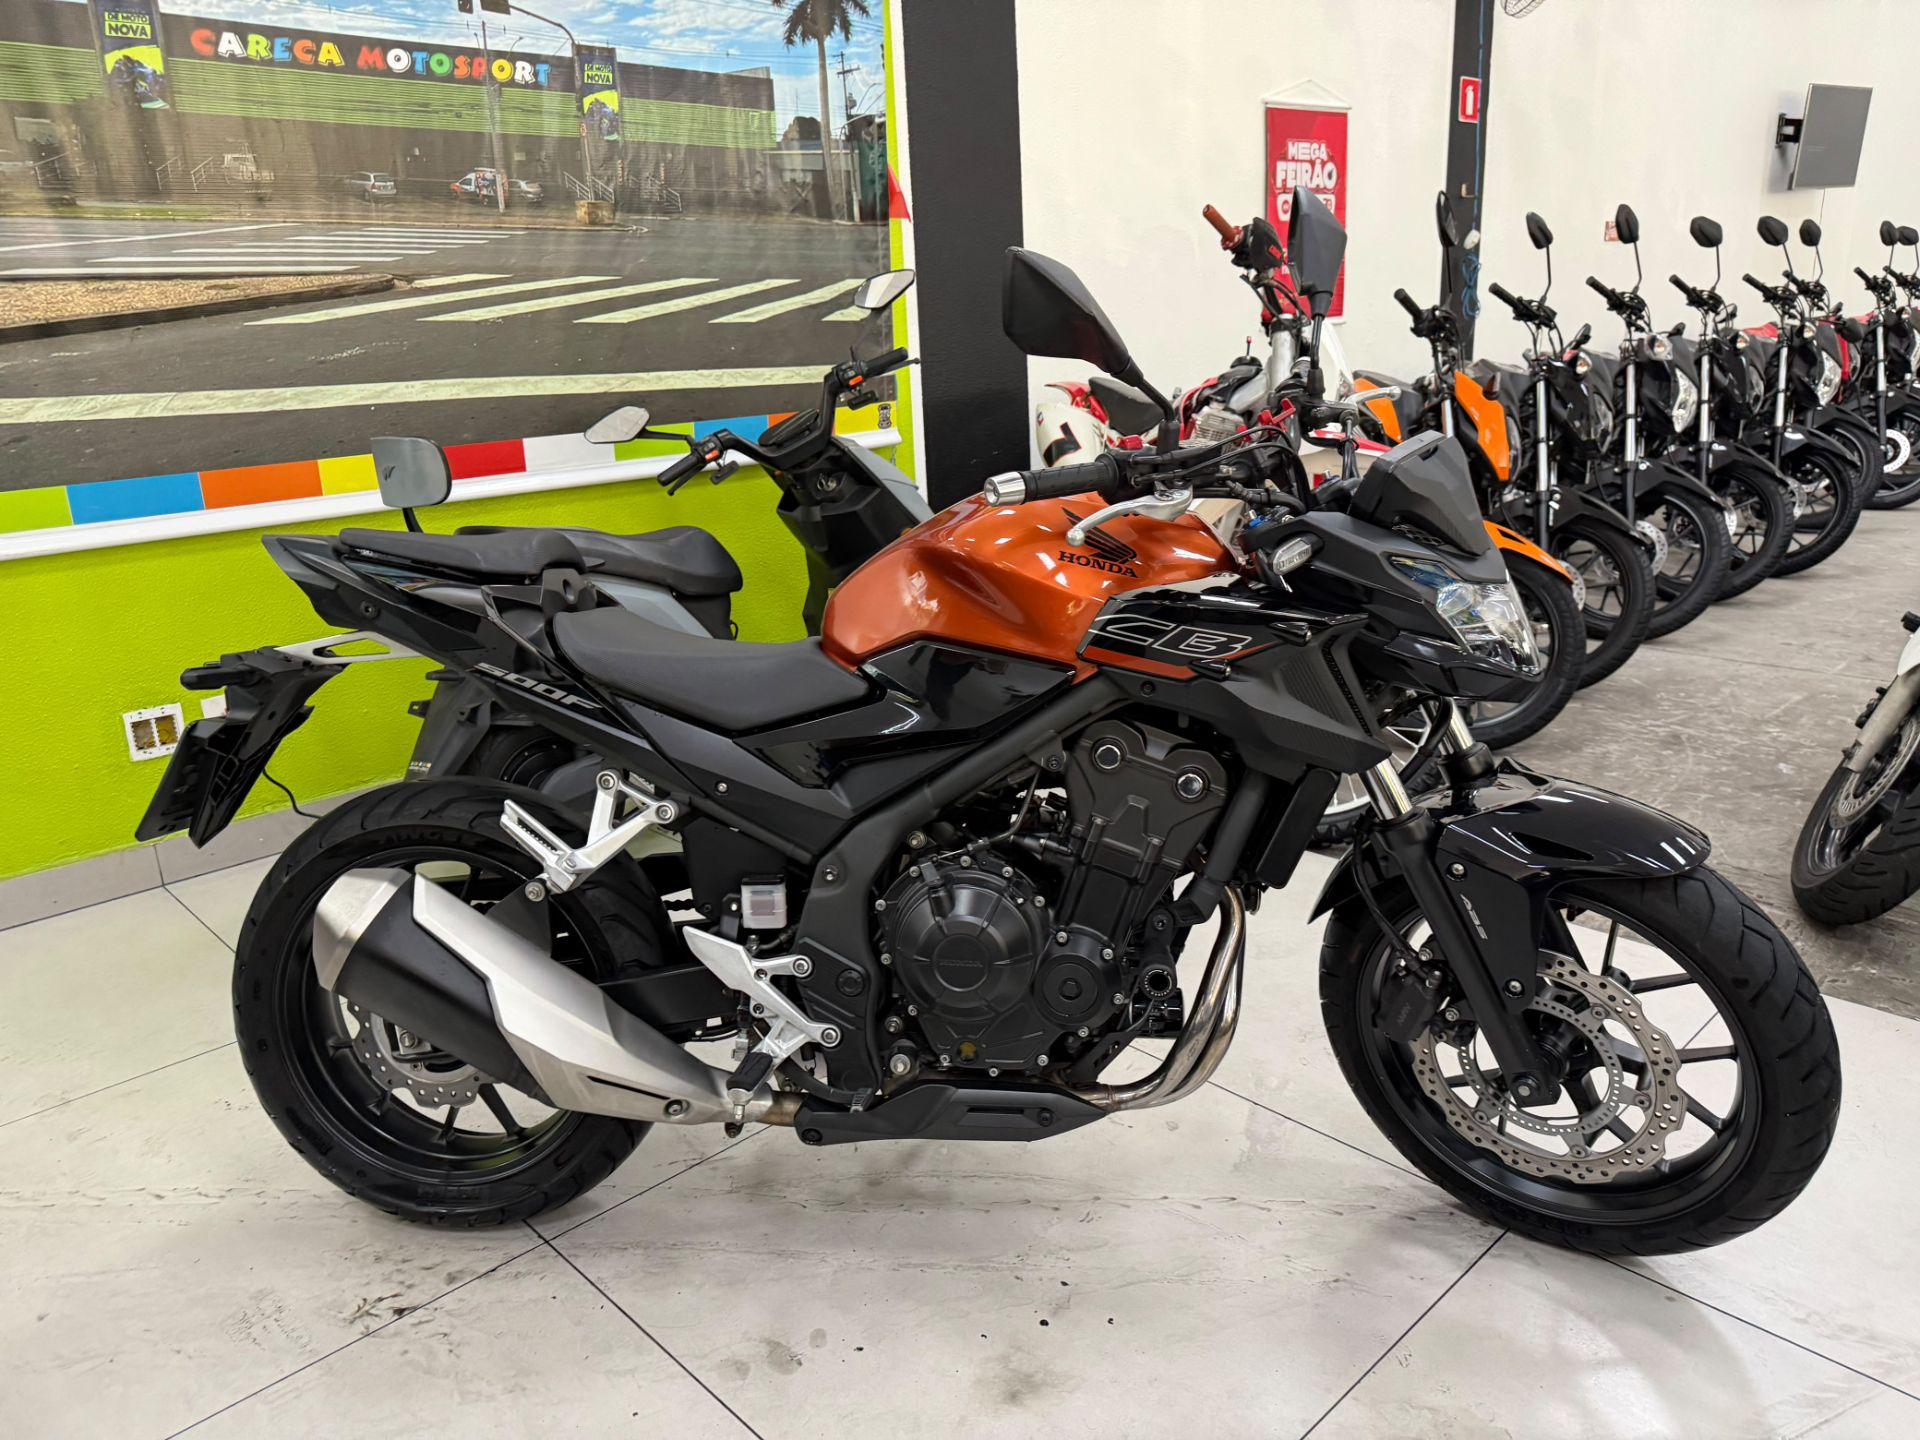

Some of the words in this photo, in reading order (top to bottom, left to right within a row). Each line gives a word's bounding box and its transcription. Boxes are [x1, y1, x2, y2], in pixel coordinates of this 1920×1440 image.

[107, 23, 148, 37] NOVA
[121, 13, 148, 23] MOTO
[190, 28, 345, 66] CARECA
[356, 45, 551, 86] MOTOSPORT
[586, 73, 611, 84] NOVA
[1287, 141, 1328, 161] MEGA
[1275, 158, 1337, 189] FEIRÃO
[1058, 550, 1138, 578] HONDA
[1088, 614, 1253, 659] CB
[470, 661, 603, 709] 500F
[1459, 893, 1488, 940] ABS
